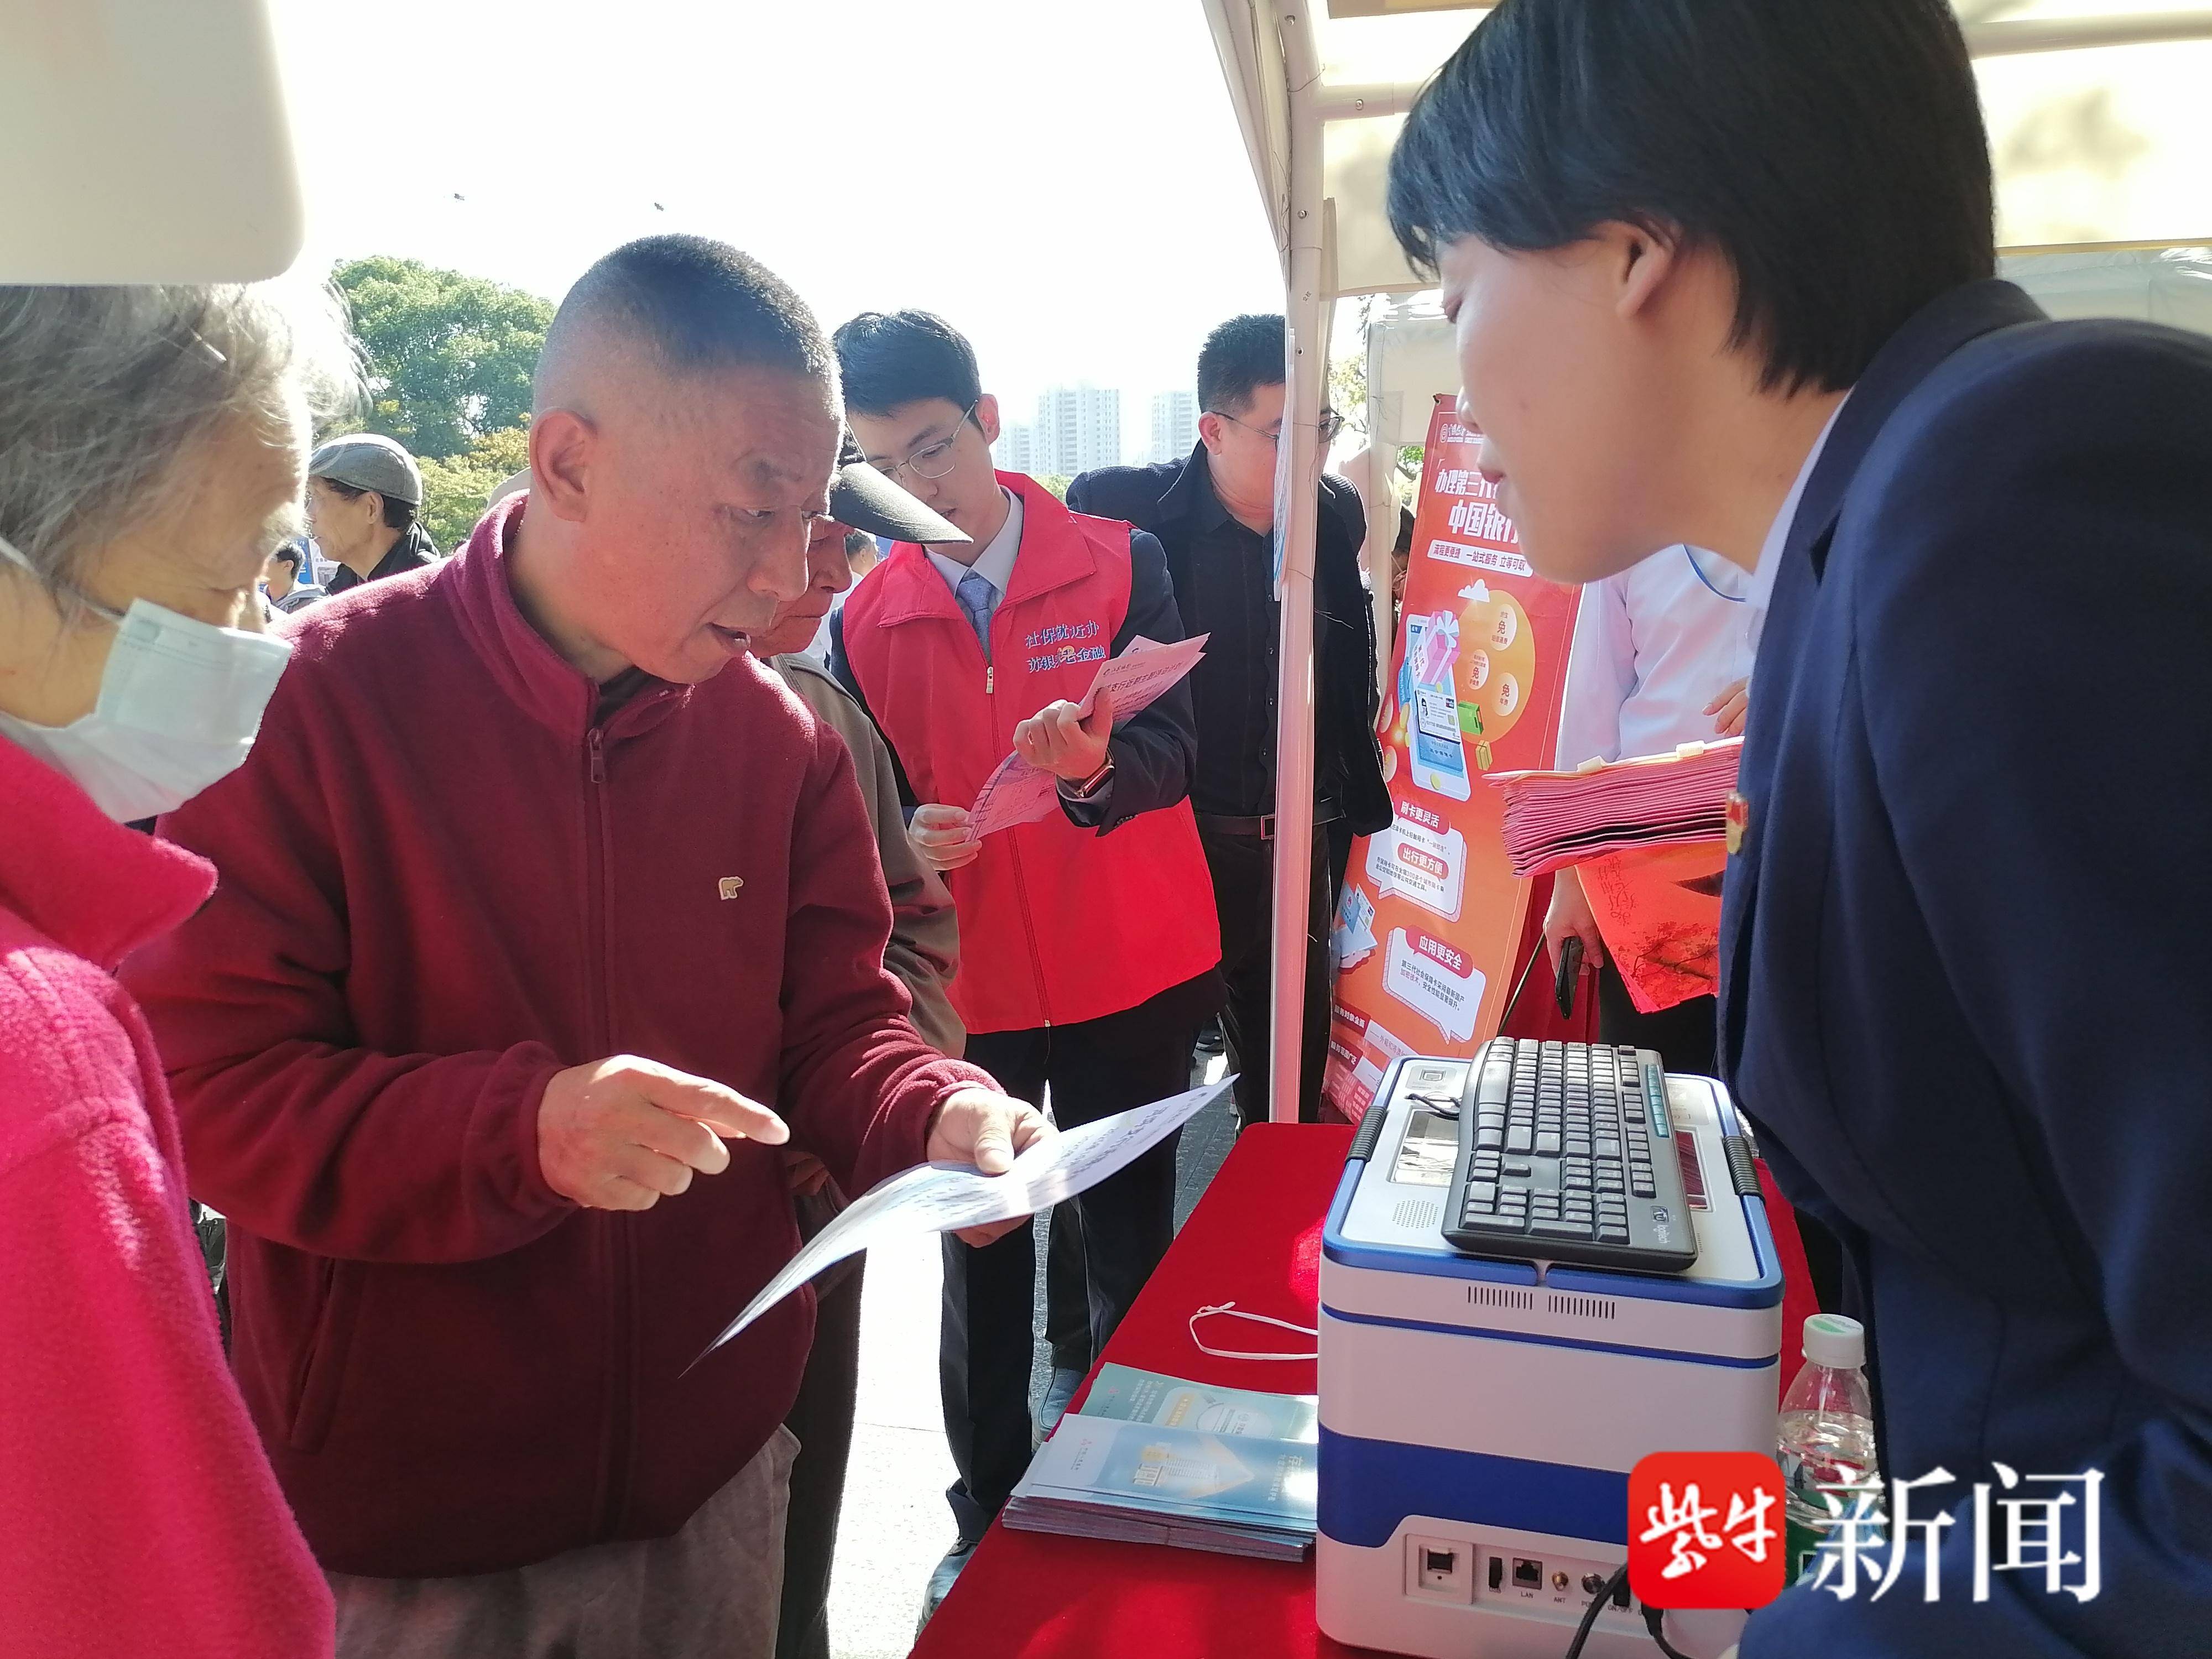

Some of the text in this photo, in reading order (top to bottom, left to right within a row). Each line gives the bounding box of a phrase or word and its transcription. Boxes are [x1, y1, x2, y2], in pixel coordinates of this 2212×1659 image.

[1434, 468, 1498, 499] 办理第三代
[1466, 550, 1498, 566] 一站式服务
[1499, 556, 1526, 571] 立等可取
[1025, 619, 1099, 649] 社保就近办
[1497, 620, 1505, 634] 免
[1472, 667, 1479, 679] 免
[1501, 684, 1510, 697] 免
[1401, 801, 1439, 828] 刷卡更灵活
[1403, 847, 1443, 876] 出行更方便
[1419, 935, 1462, 971] 应用更安全
